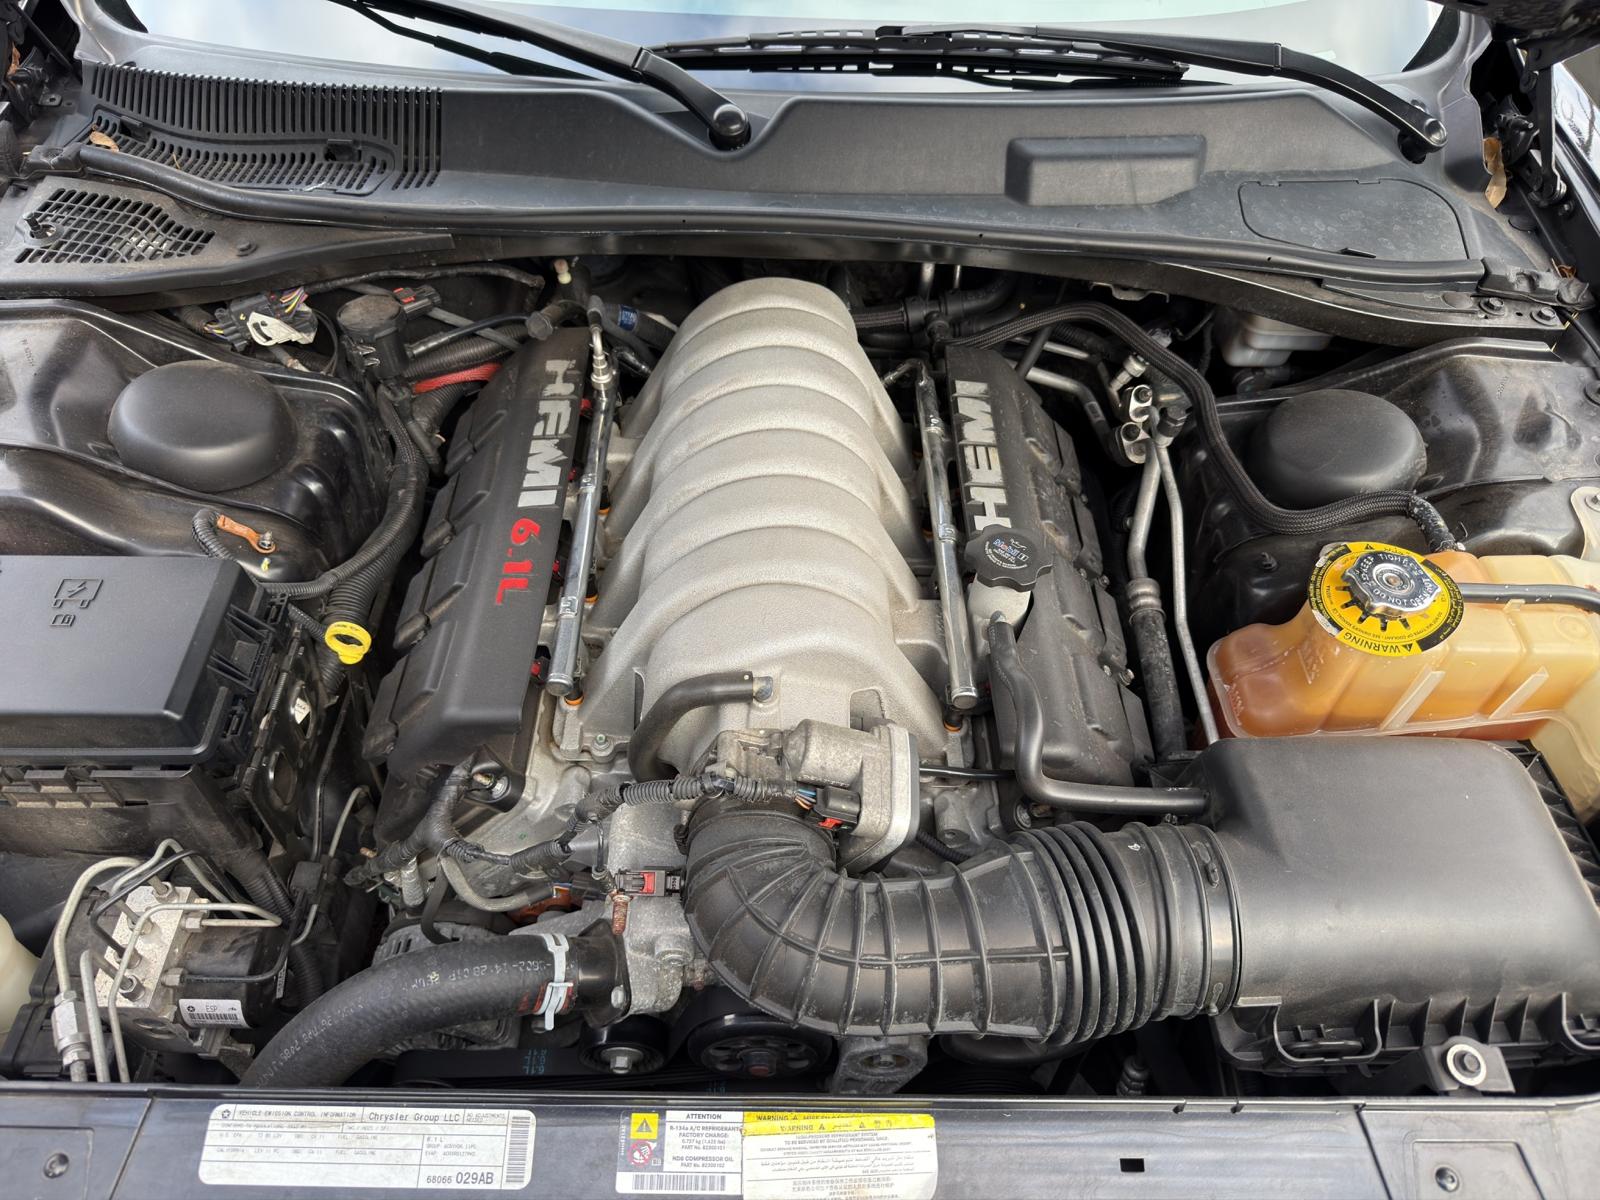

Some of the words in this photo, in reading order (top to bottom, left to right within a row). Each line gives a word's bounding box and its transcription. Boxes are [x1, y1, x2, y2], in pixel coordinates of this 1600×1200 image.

[517, 359, 579, 508] HEMI
[955, 380, 1013, 531] HEMI
[496, 517, 542, 605] 6.1L
[1387, 597, 1408, 606] NOT
[1343, 632, 1402, 653] WARNING
[368, 1112, 409, 1123] Chrysler
[414, 1112, 440, 1123] Group
[443, 1113, 461, 1122] LLC
[456, 1172, 494, 1185] 029AB
